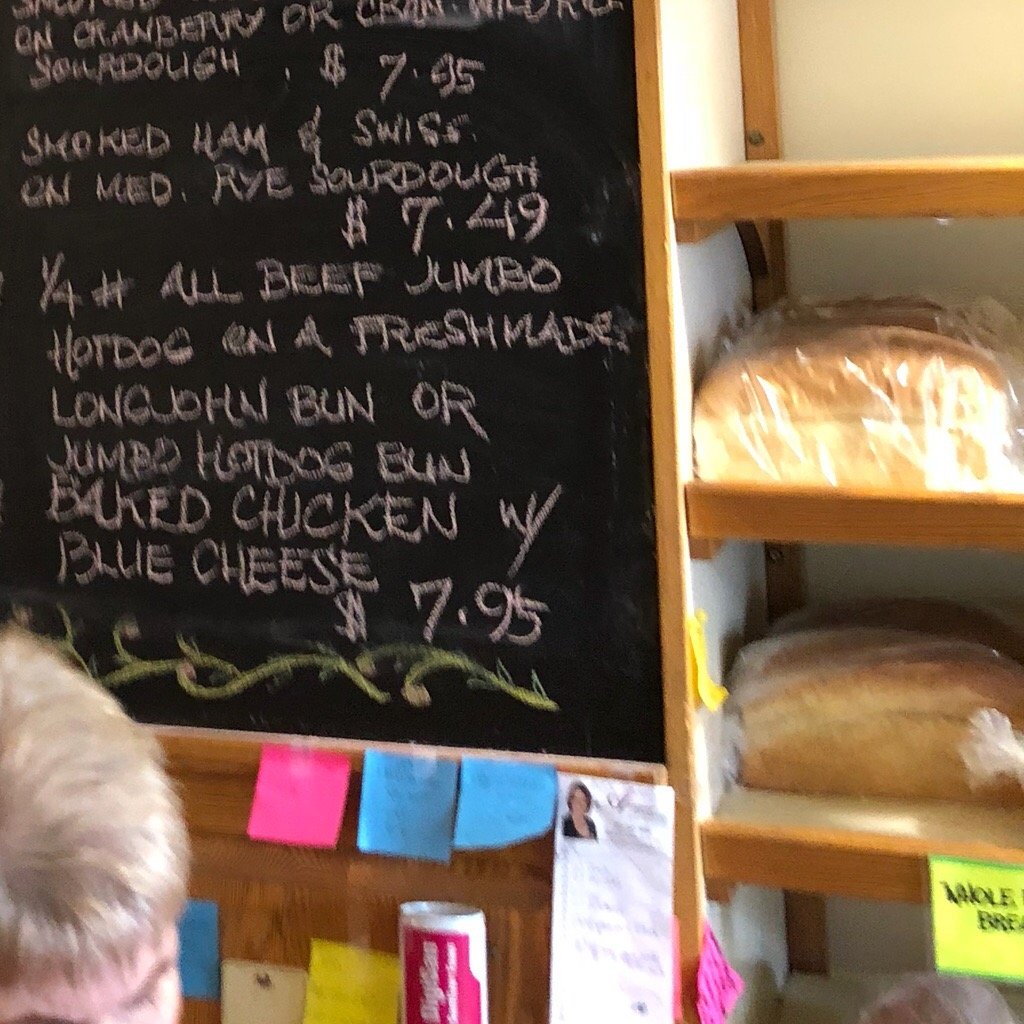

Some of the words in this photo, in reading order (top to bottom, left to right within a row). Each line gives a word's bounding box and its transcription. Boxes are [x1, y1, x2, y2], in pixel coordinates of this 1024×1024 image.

[15, 22, 54, 56] ON
[74, 7, 267, 51] CRANBERRY
[30, 45, 241, 91] SOURDOUGH
[320, 43, 348, 89] $
[379, 50, 486, 103] 7.95
[21, 124, 172, 168] SMOKED
[192, 121, 270, 166] HAM
[21, 172, 71, 208] ON
[212, 163, 295, 207] RYE
[309, 153, 541, 195] SOURDOUGH
[341, 194, 369, 250] $
[401, 191, 551, 257] 7.49
[161, 261, 244, 307] ALL
[255, 257, 384, 302] BEEF
[403, 255, 562, 296] JUMBO
[222, 318, 277, 358] ON
[294, 314, 334, 359] A
[286, 381, 376, 427] BUN
[411, 380, 490, 443] OR
[46, 434, 182, 481] JUMBO
[377, 441, 472, 485] BUN
[44, 473, 213, 533] BAKED
[232, 484, 458, 545] CHICKEN
[57, 530, 175, 586] BLUE
[191, 537, 379, 596] CHEESE
[333, 588, 369, 644] $
[408, 576, 552, 647] 7.95
